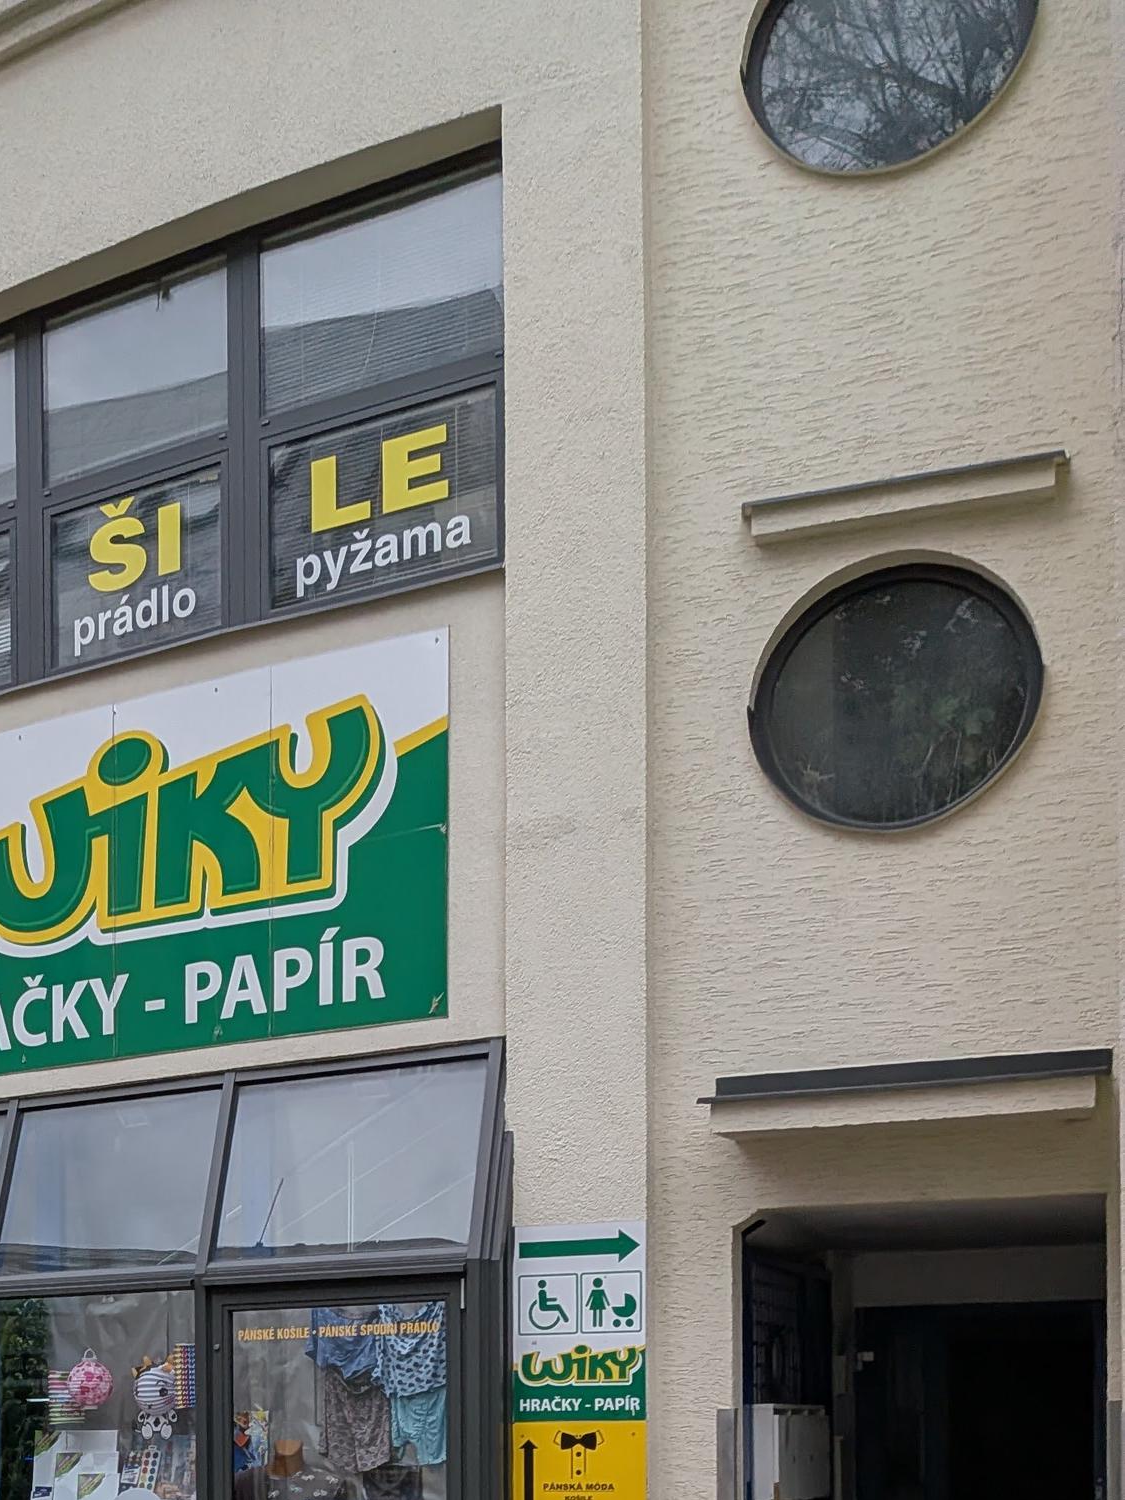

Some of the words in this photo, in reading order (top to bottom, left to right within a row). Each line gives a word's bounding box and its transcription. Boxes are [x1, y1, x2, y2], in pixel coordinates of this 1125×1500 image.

[87, 495, 182, 593] ŠI
[310, 423, 450, 534] LE
[74, 584, 197, 658] prádlo
[296, 514, 472, 598] pyžama
[183, 926, 387, 1026] PAPÍR
[238, 1326, 275, 1342] PÁNSKÉ
[276, 1325, 310, 1340] KOŠILE
[319, 1323, 358, 1338] PÁNSKÉ
[519, 1395, 582, 1412] HRAČKY
[594, 1394, 641, 1412] PAPÍR
[543, 1482, 583, 1491] PÁNSKÁ
[585, 1482, 615, 1491] MÓDA
